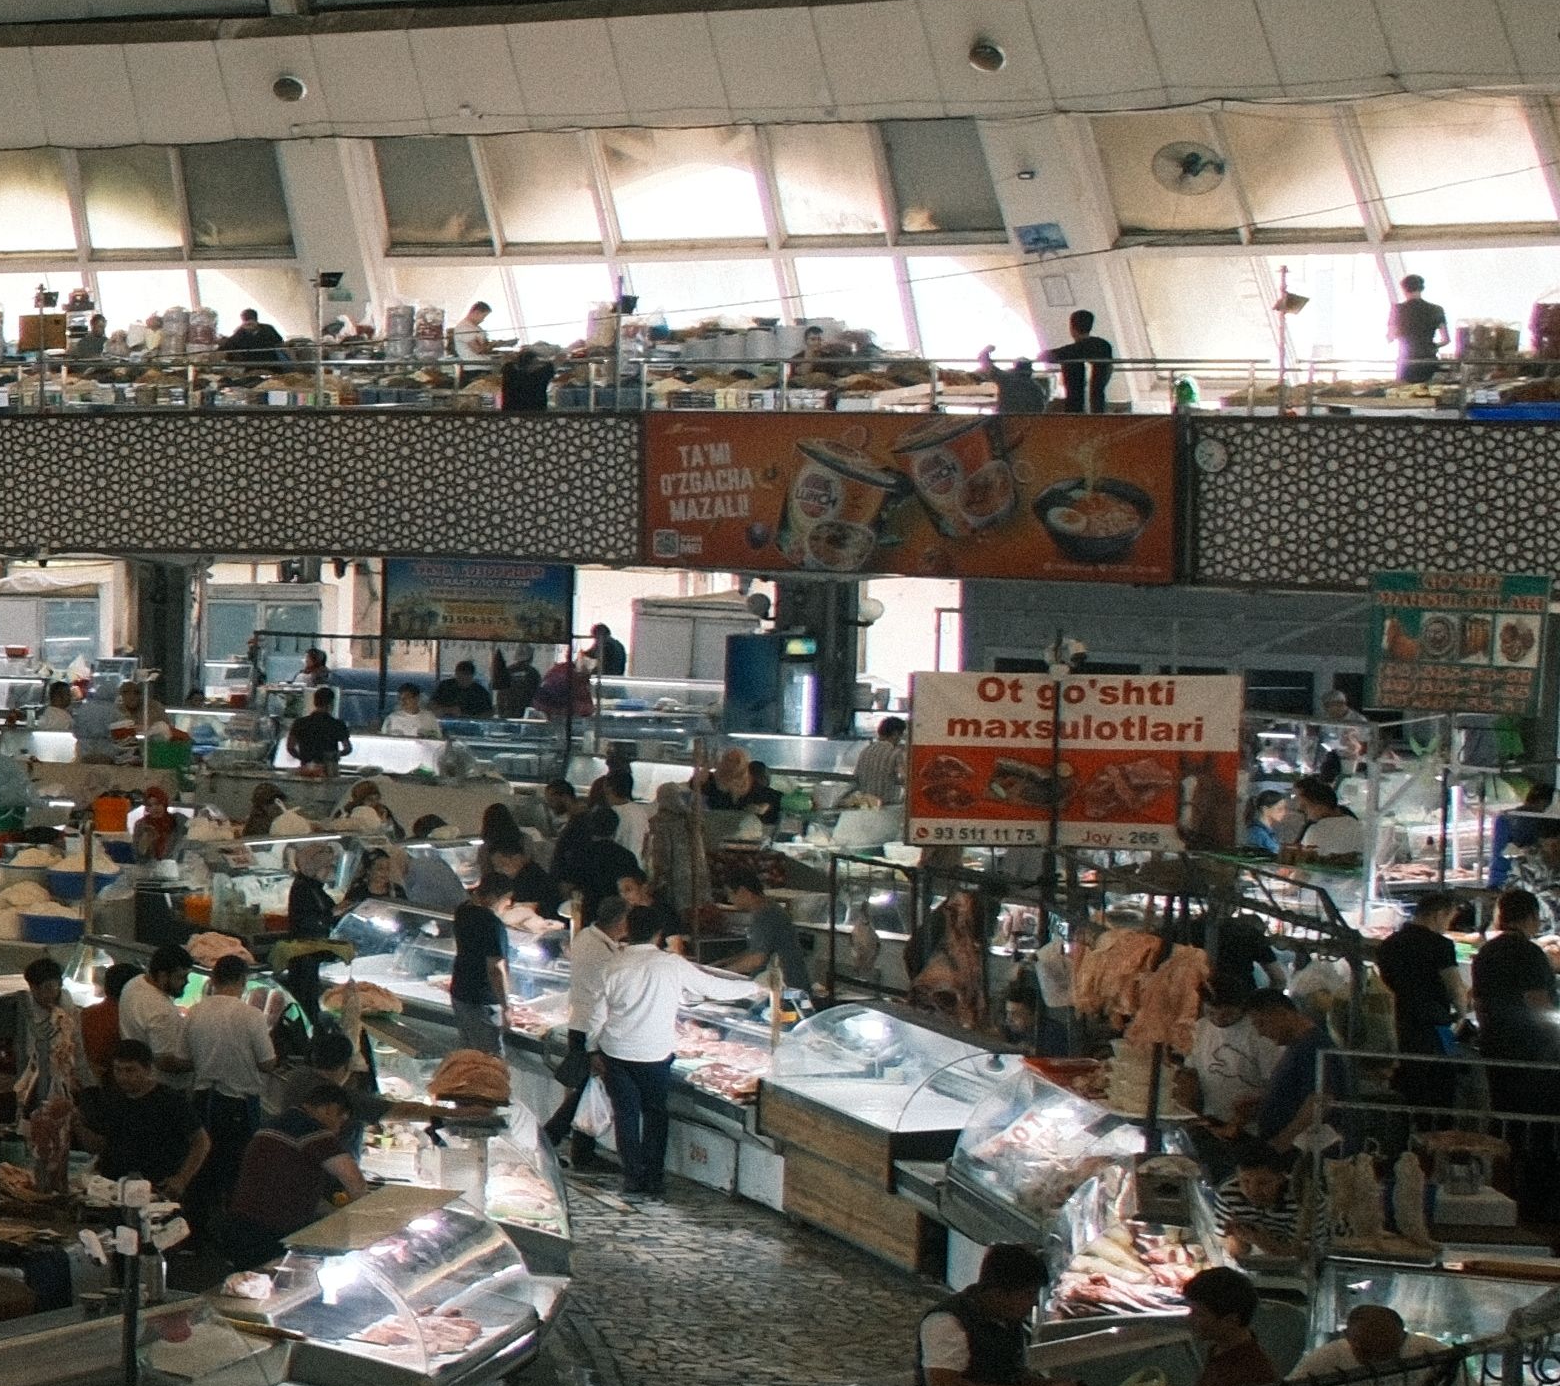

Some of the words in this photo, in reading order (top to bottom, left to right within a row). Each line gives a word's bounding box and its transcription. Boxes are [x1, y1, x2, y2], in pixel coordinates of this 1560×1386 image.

[658, 467, 755, 496] O'ZGACHA
[977, 676, 1023, 704] Ot
[1037, 678, 1176, 711] go'shti
[947, 714, 1205, 743] maxsulotlari
[933, 827, 954, 840] 93
[960, 827, 986, 841] 511
[993, 828, 1010, 841] 11
[1016, 828, 1036, 842] 75
[1082, 830, 1113, 847] Joy
